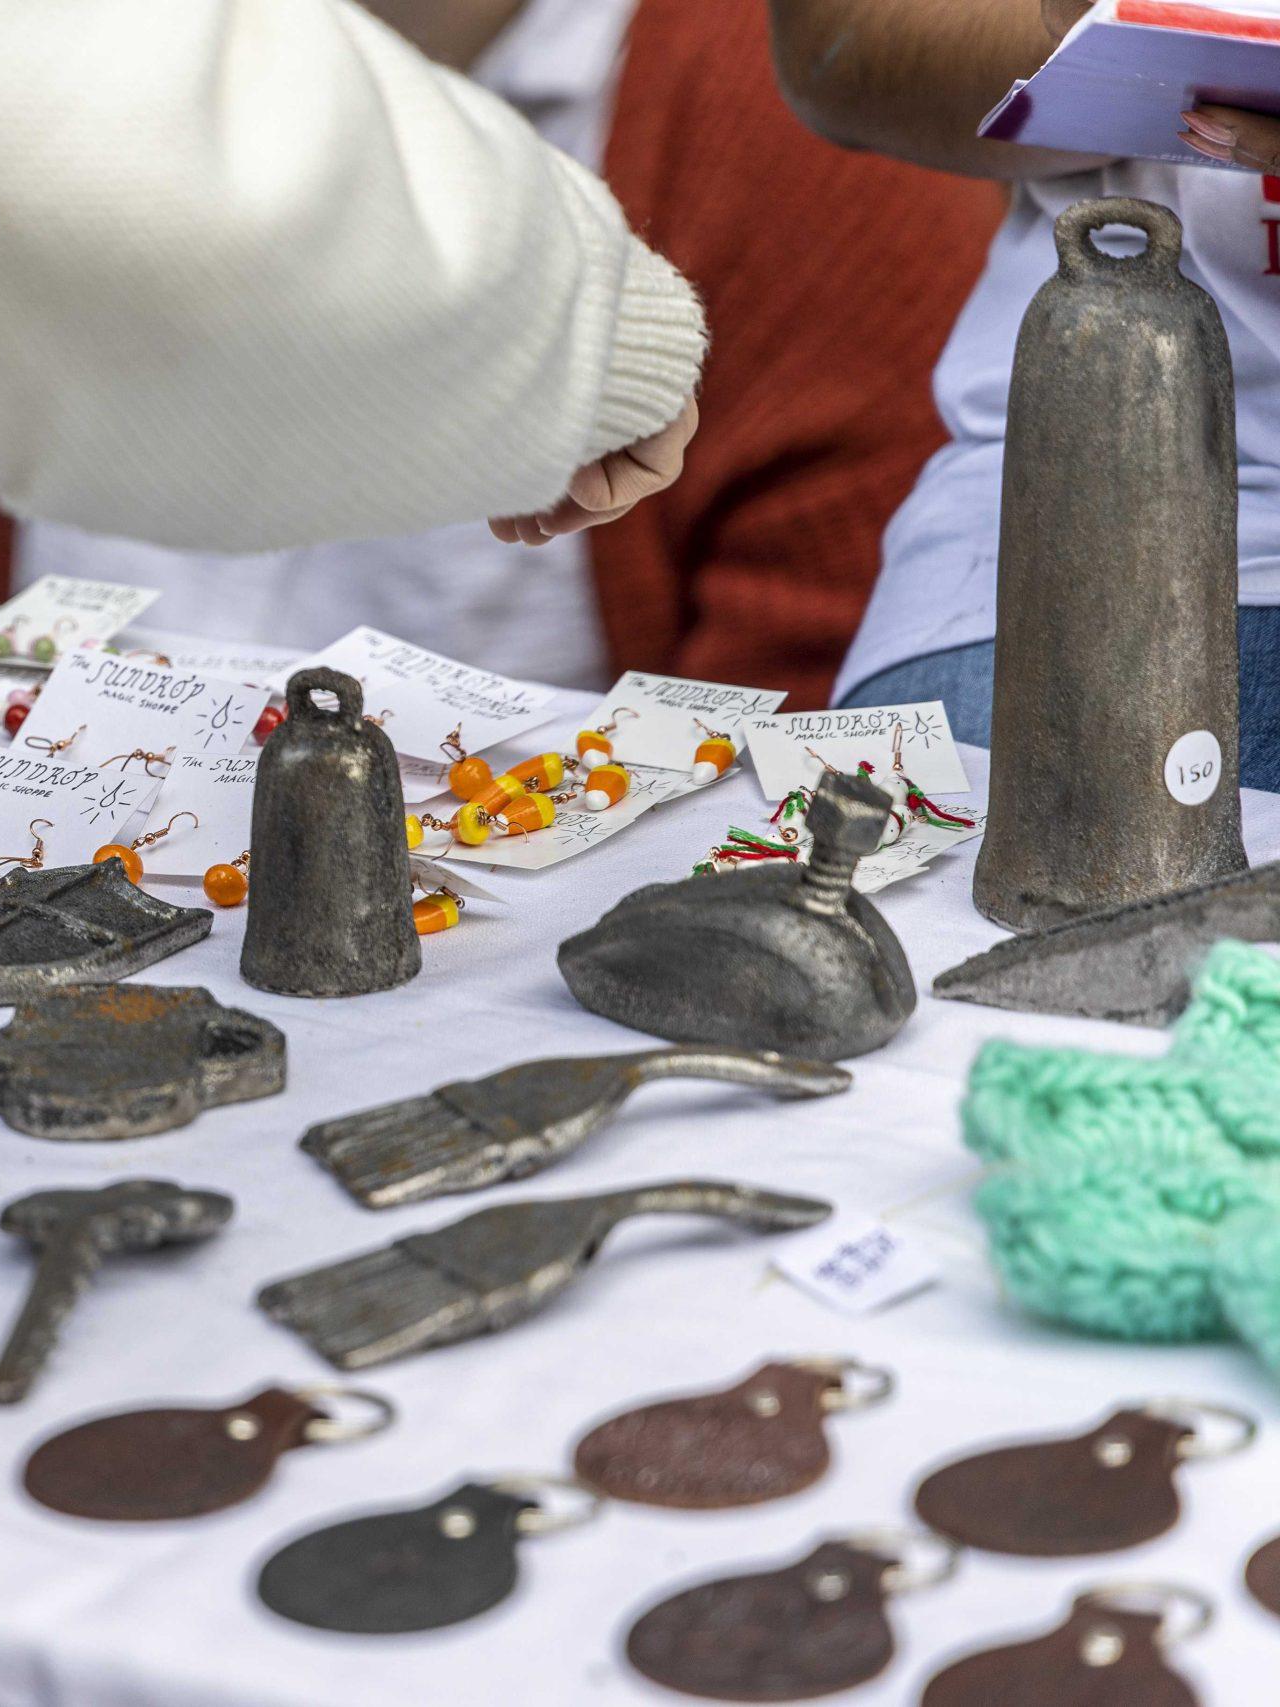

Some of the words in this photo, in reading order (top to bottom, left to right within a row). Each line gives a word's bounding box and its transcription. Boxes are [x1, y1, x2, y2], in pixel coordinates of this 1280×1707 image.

[71, 654, 91, 670] The
[85, 660, 206, 704] SUNDROP
[627, 676, 646, 688] The
[644, 681, 743, 706] SUNDROP
[98, 689, 135, 703] MAGIC
[139, 698, 179, 715] SHOPPE
[753, 720, 779, 729] The
[785, 710, 900, 735] SUNDROP
[794, 732, 838, 741] MAGIC
[843, 728, 887, 738] SHOPPE
[182, 756, 203, 767] The
[1176, 761, 1213, 785] 150
[12, 785, 54, 799] SHOPPE
